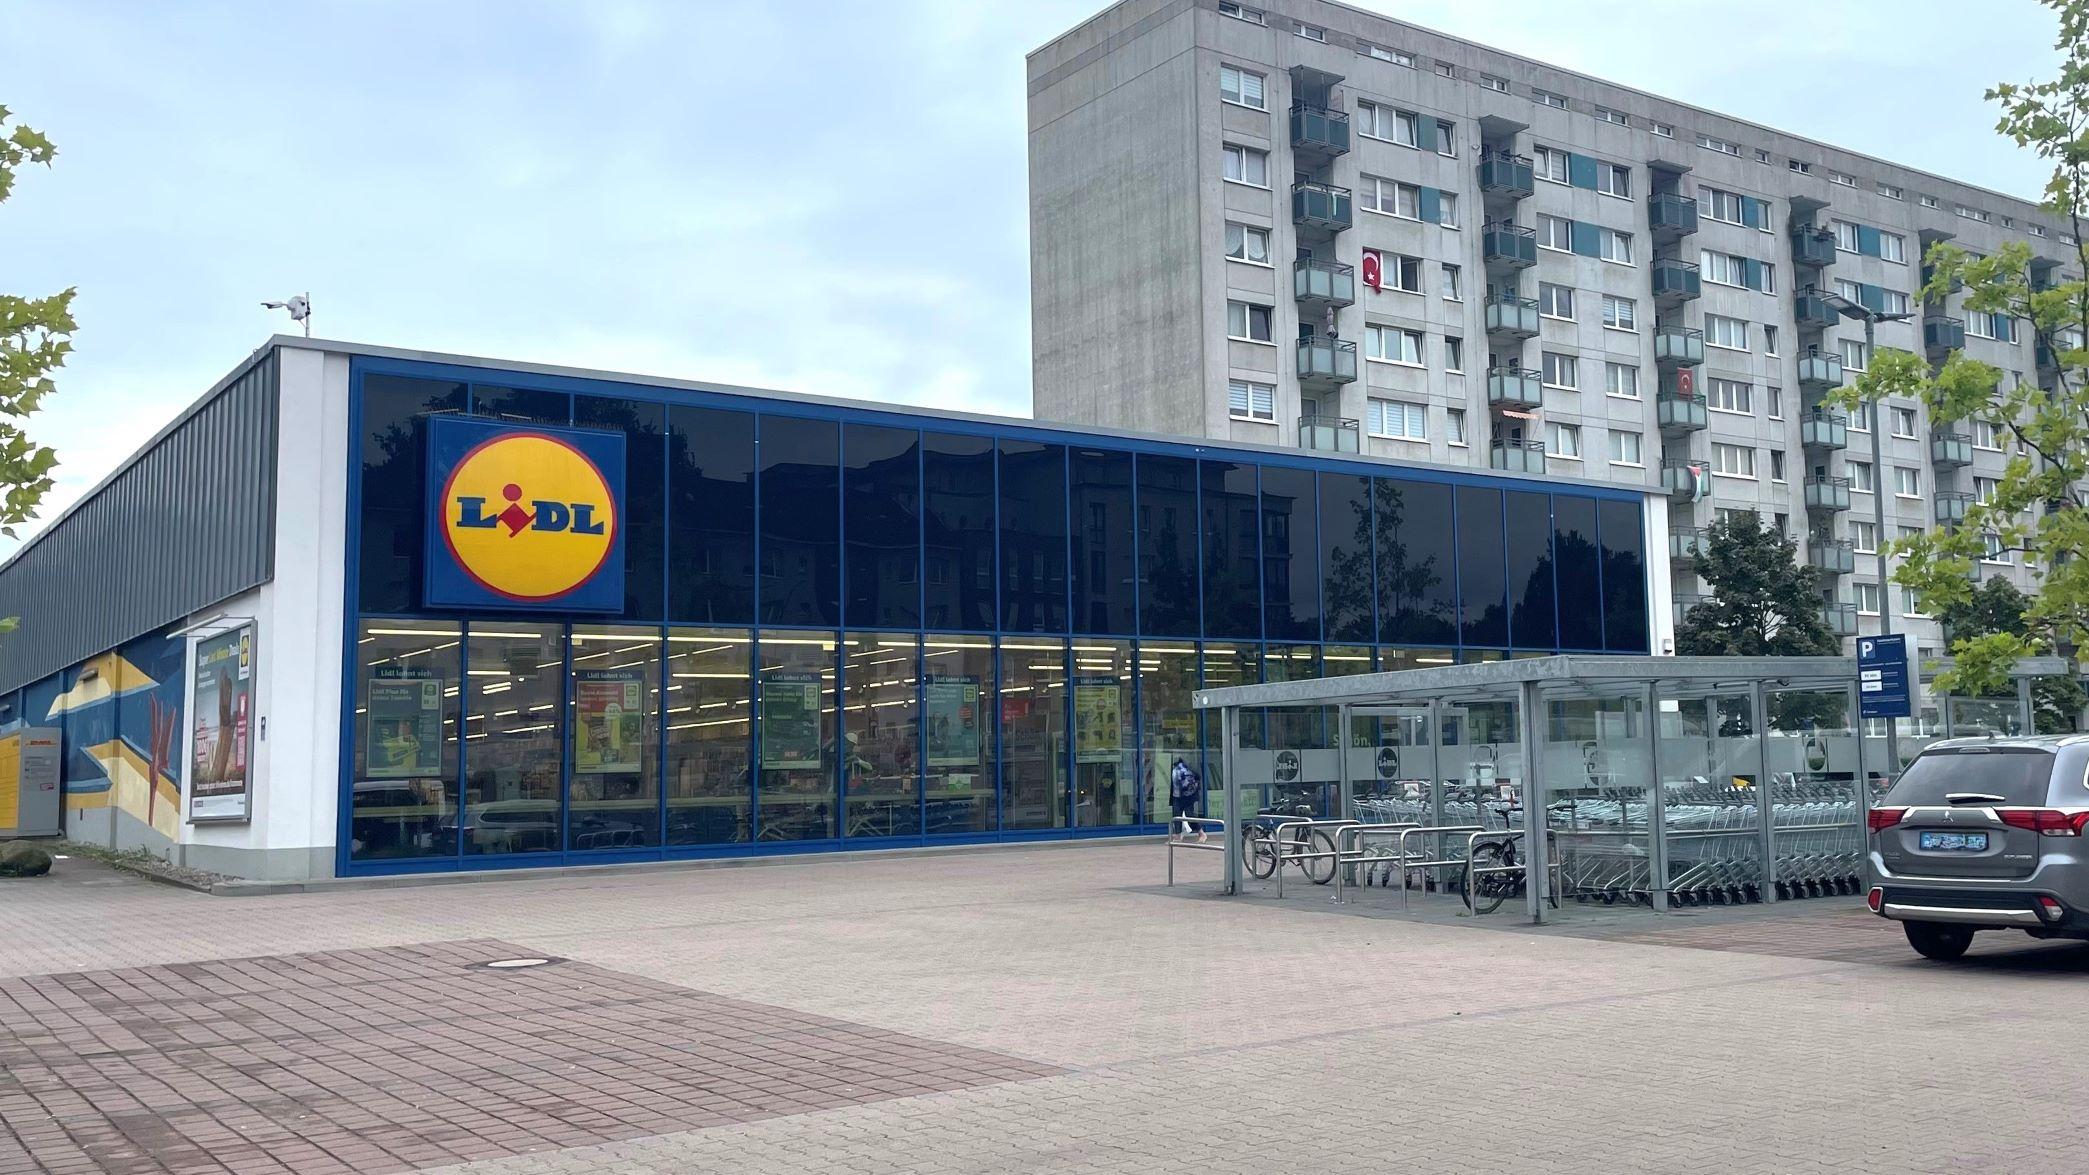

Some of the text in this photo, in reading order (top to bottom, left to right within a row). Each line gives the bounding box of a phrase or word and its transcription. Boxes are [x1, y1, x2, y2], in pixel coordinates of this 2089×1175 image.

[1861, 641, 1873, 657] P
[417, 670, 432, 678] sich
[1332, 733, 1371, 747] Sön.
